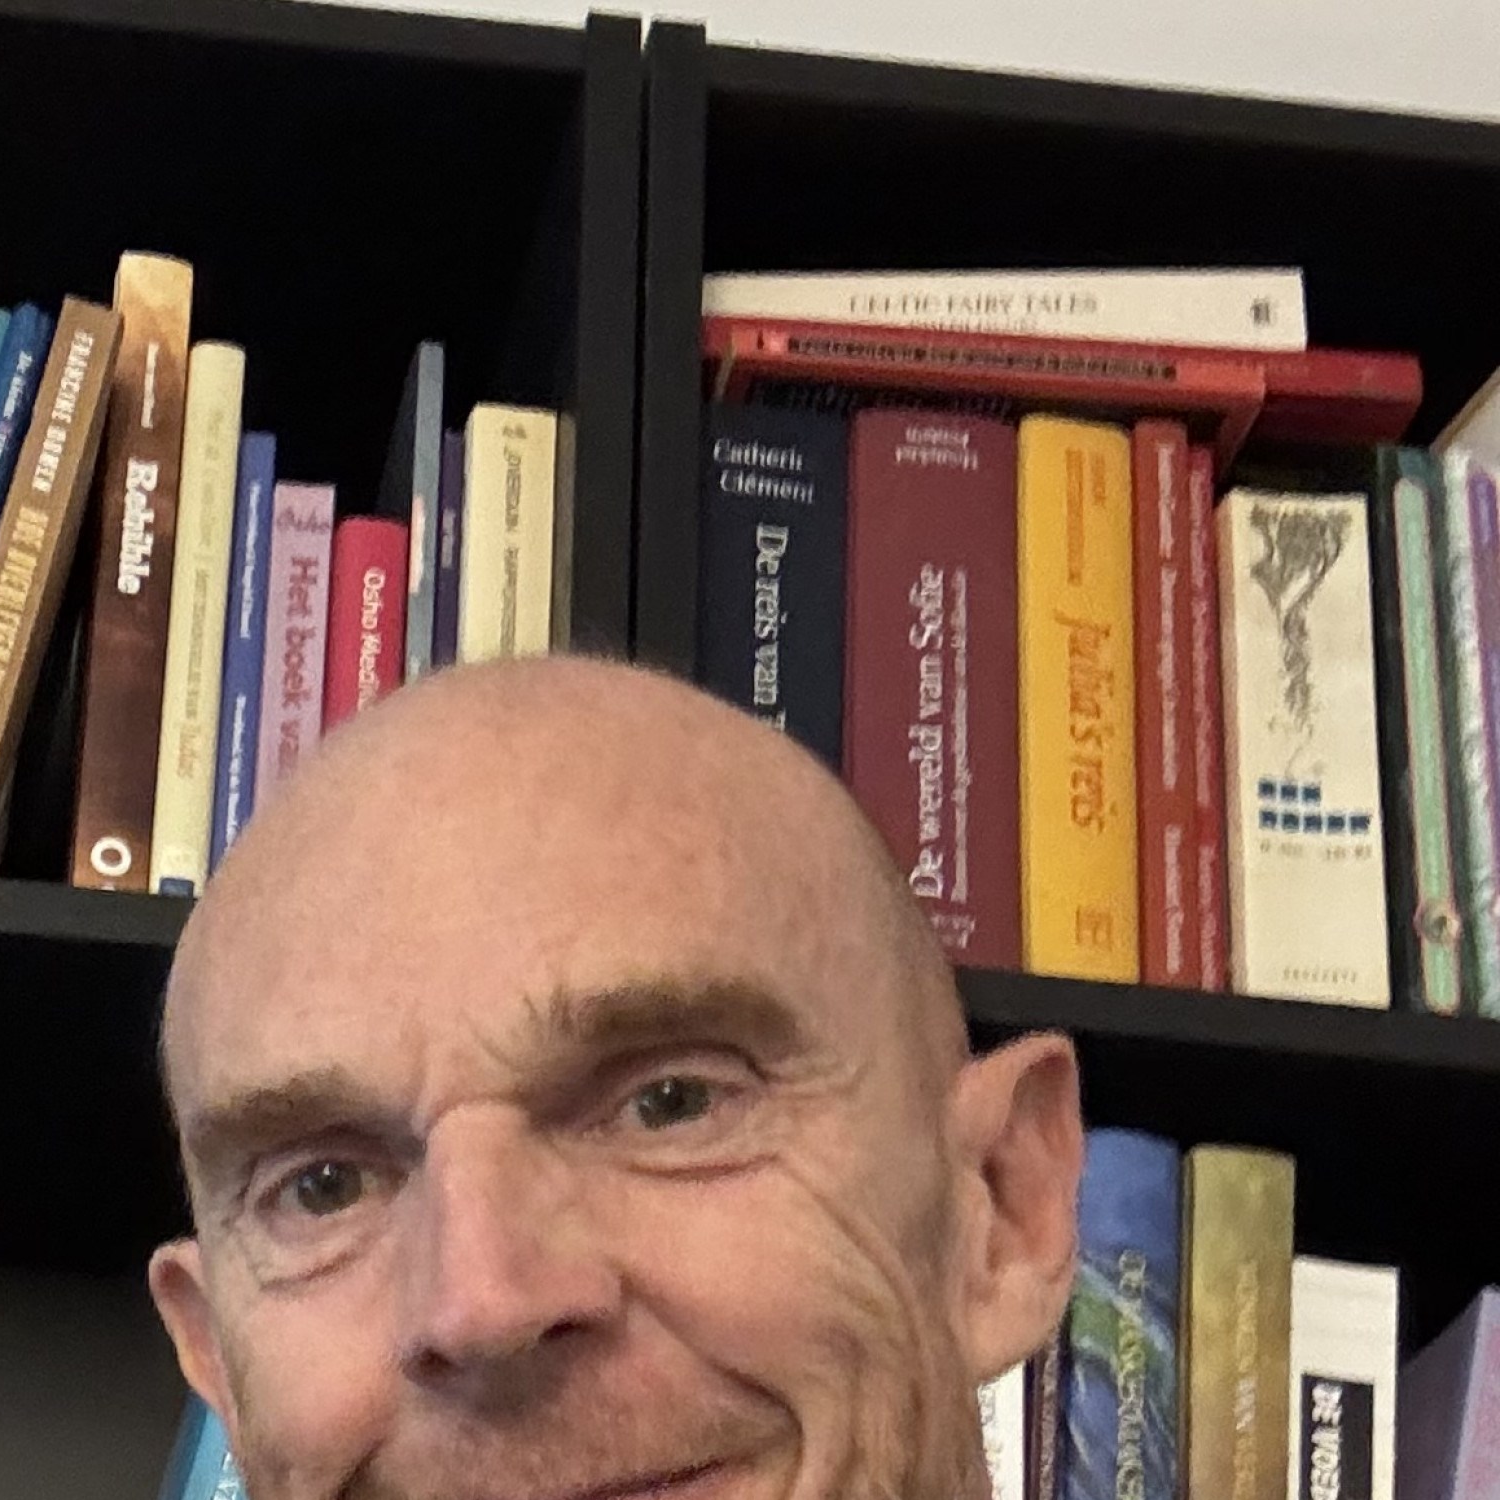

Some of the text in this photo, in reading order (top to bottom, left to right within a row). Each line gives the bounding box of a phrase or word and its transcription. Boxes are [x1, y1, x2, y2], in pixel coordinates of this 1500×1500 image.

[29, 327, 95, 496] FRANCINE OOMEN
[115, 456, 159, 596] Rebible
[286, 554, 319, 622] Het
[360, 566, 386, 630] Osho
[752, 523, 789, 705] De reis van
[279, 625, 315, 712] boek
[907, 563, 945, 899] De wereld van Sofie
[1311, 1384, 1343, 1424] DE
